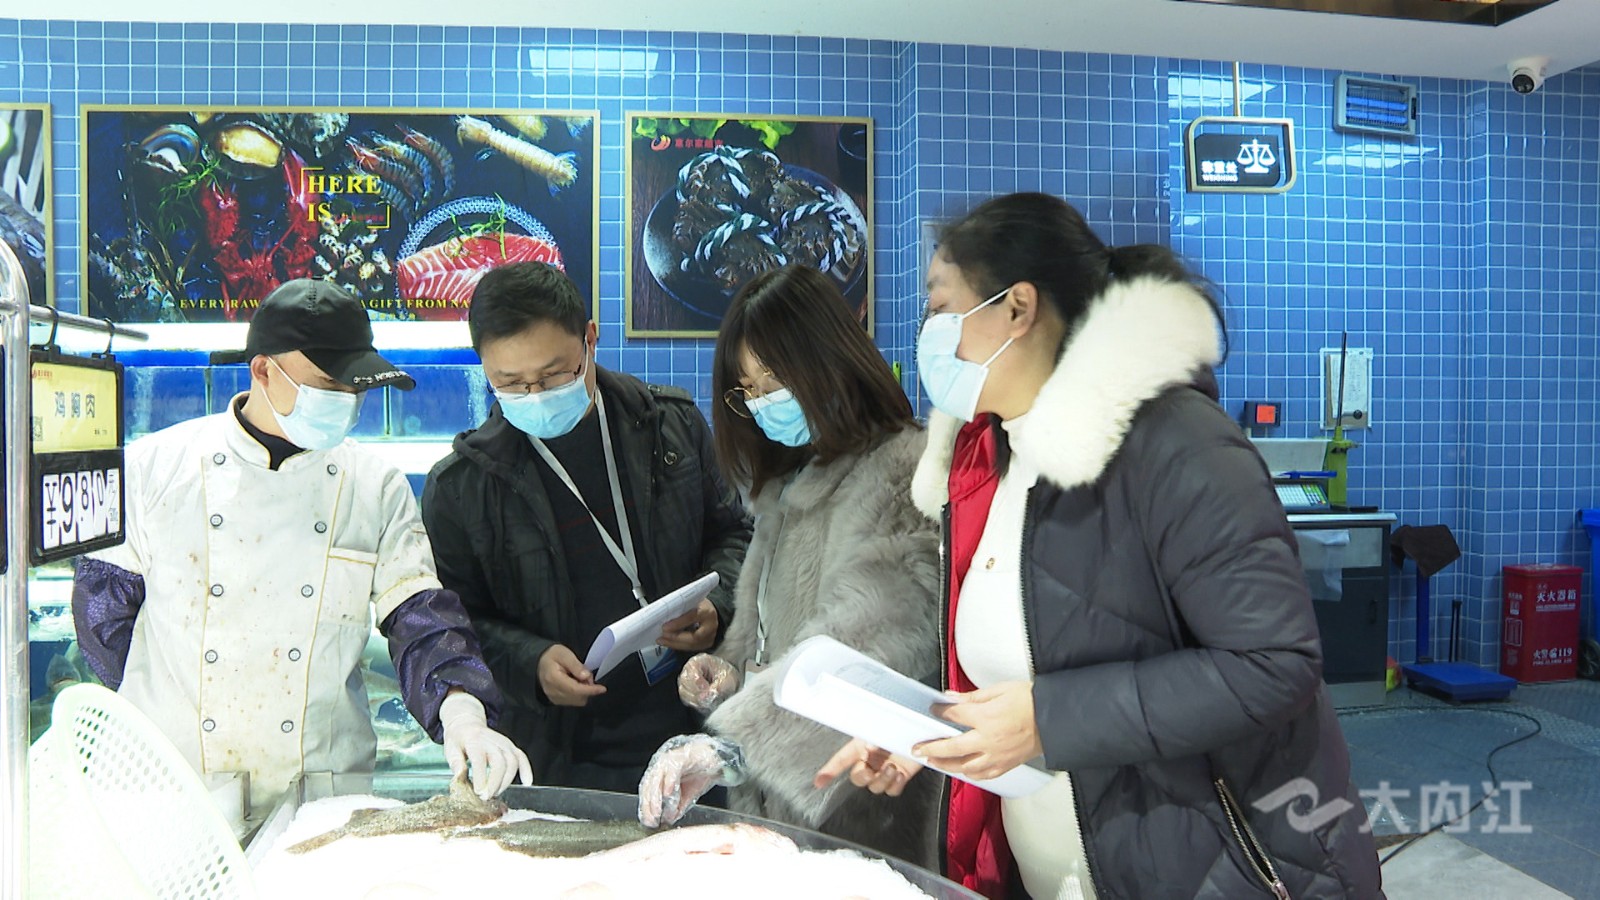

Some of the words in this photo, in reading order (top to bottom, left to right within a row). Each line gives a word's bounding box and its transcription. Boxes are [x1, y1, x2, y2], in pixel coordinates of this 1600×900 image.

[308, 174, 382, 194] HERE
[307, 202, 333, 222] IS
[179, 299, 229, 309] EVERY
[230, 299, 261, 309] RAW
[369, 299, 403, 309] GIFT
[406, 299, 447, 309] FROM
